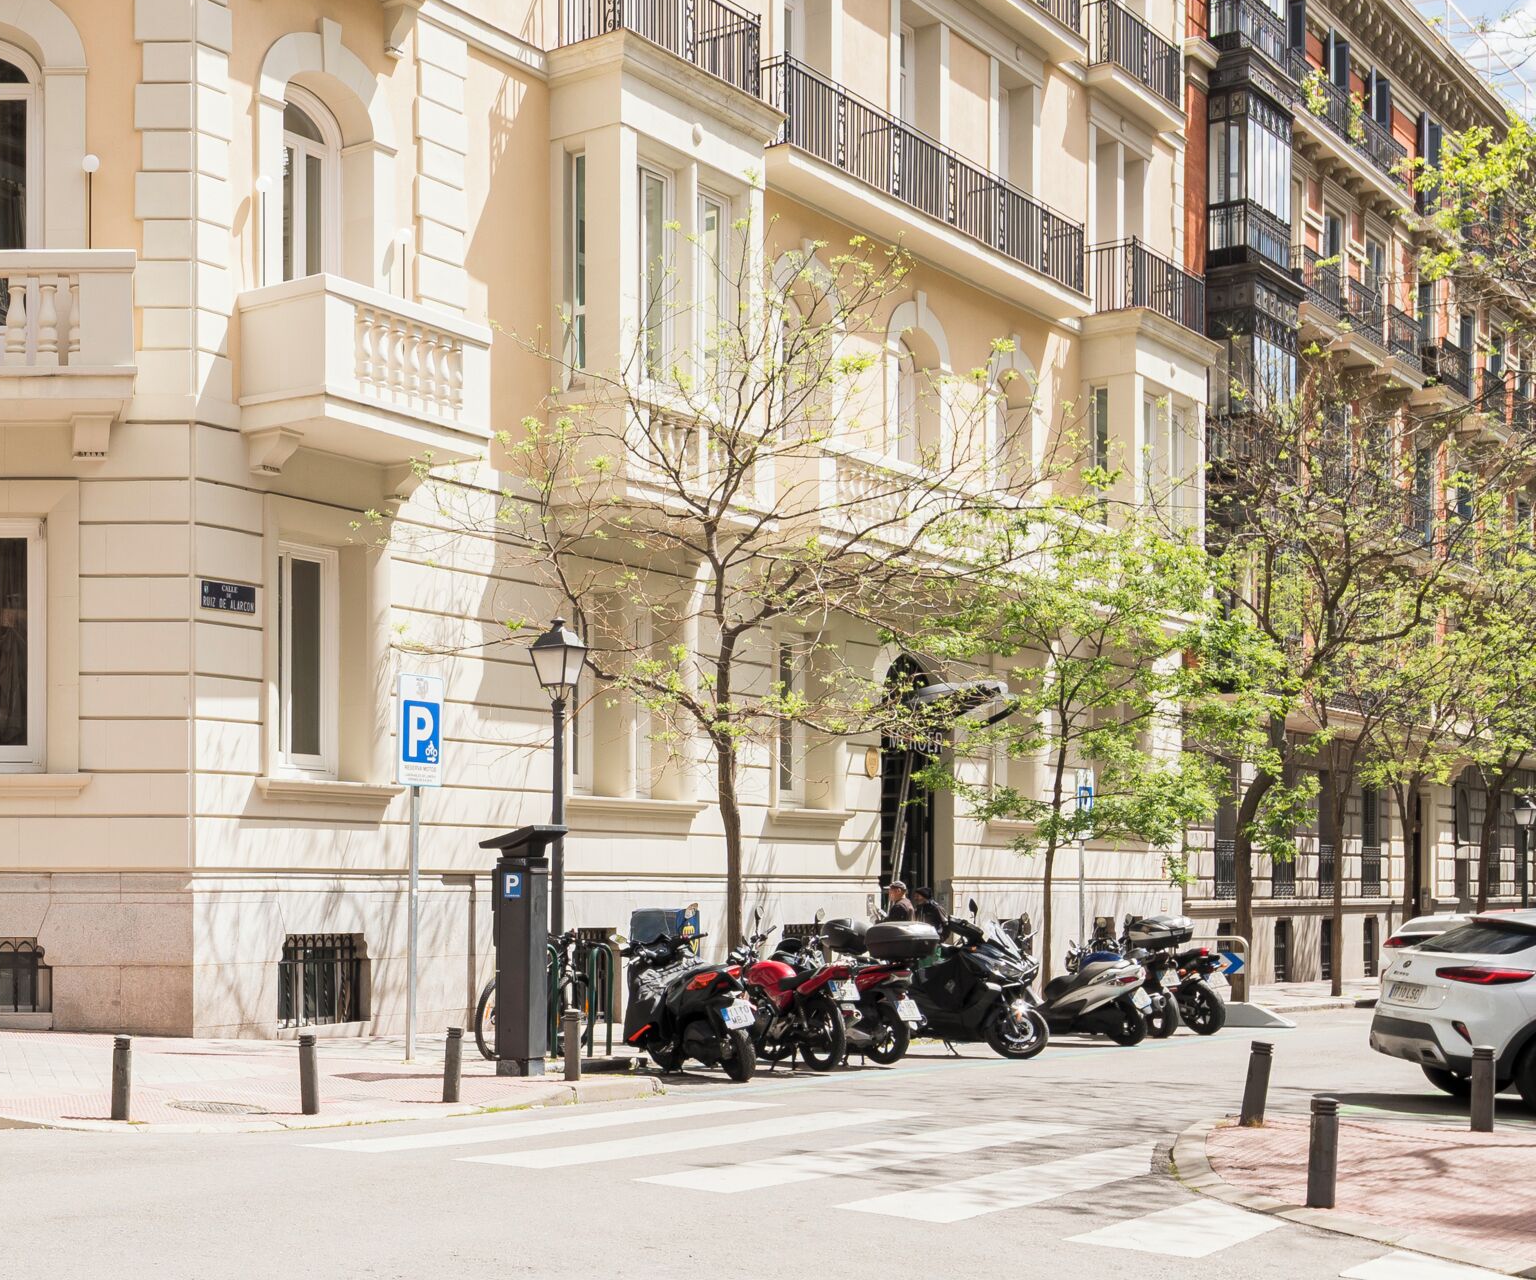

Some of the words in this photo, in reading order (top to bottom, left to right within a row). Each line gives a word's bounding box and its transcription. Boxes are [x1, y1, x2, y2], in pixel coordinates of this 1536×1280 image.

[221, 585, 238, 593] CALLE
[203, 596, 216, 608] RUIZ
[219, 598, 227, 609] DE
[408, 705, 434, 758] P
[506, 875, 519, 894] P
